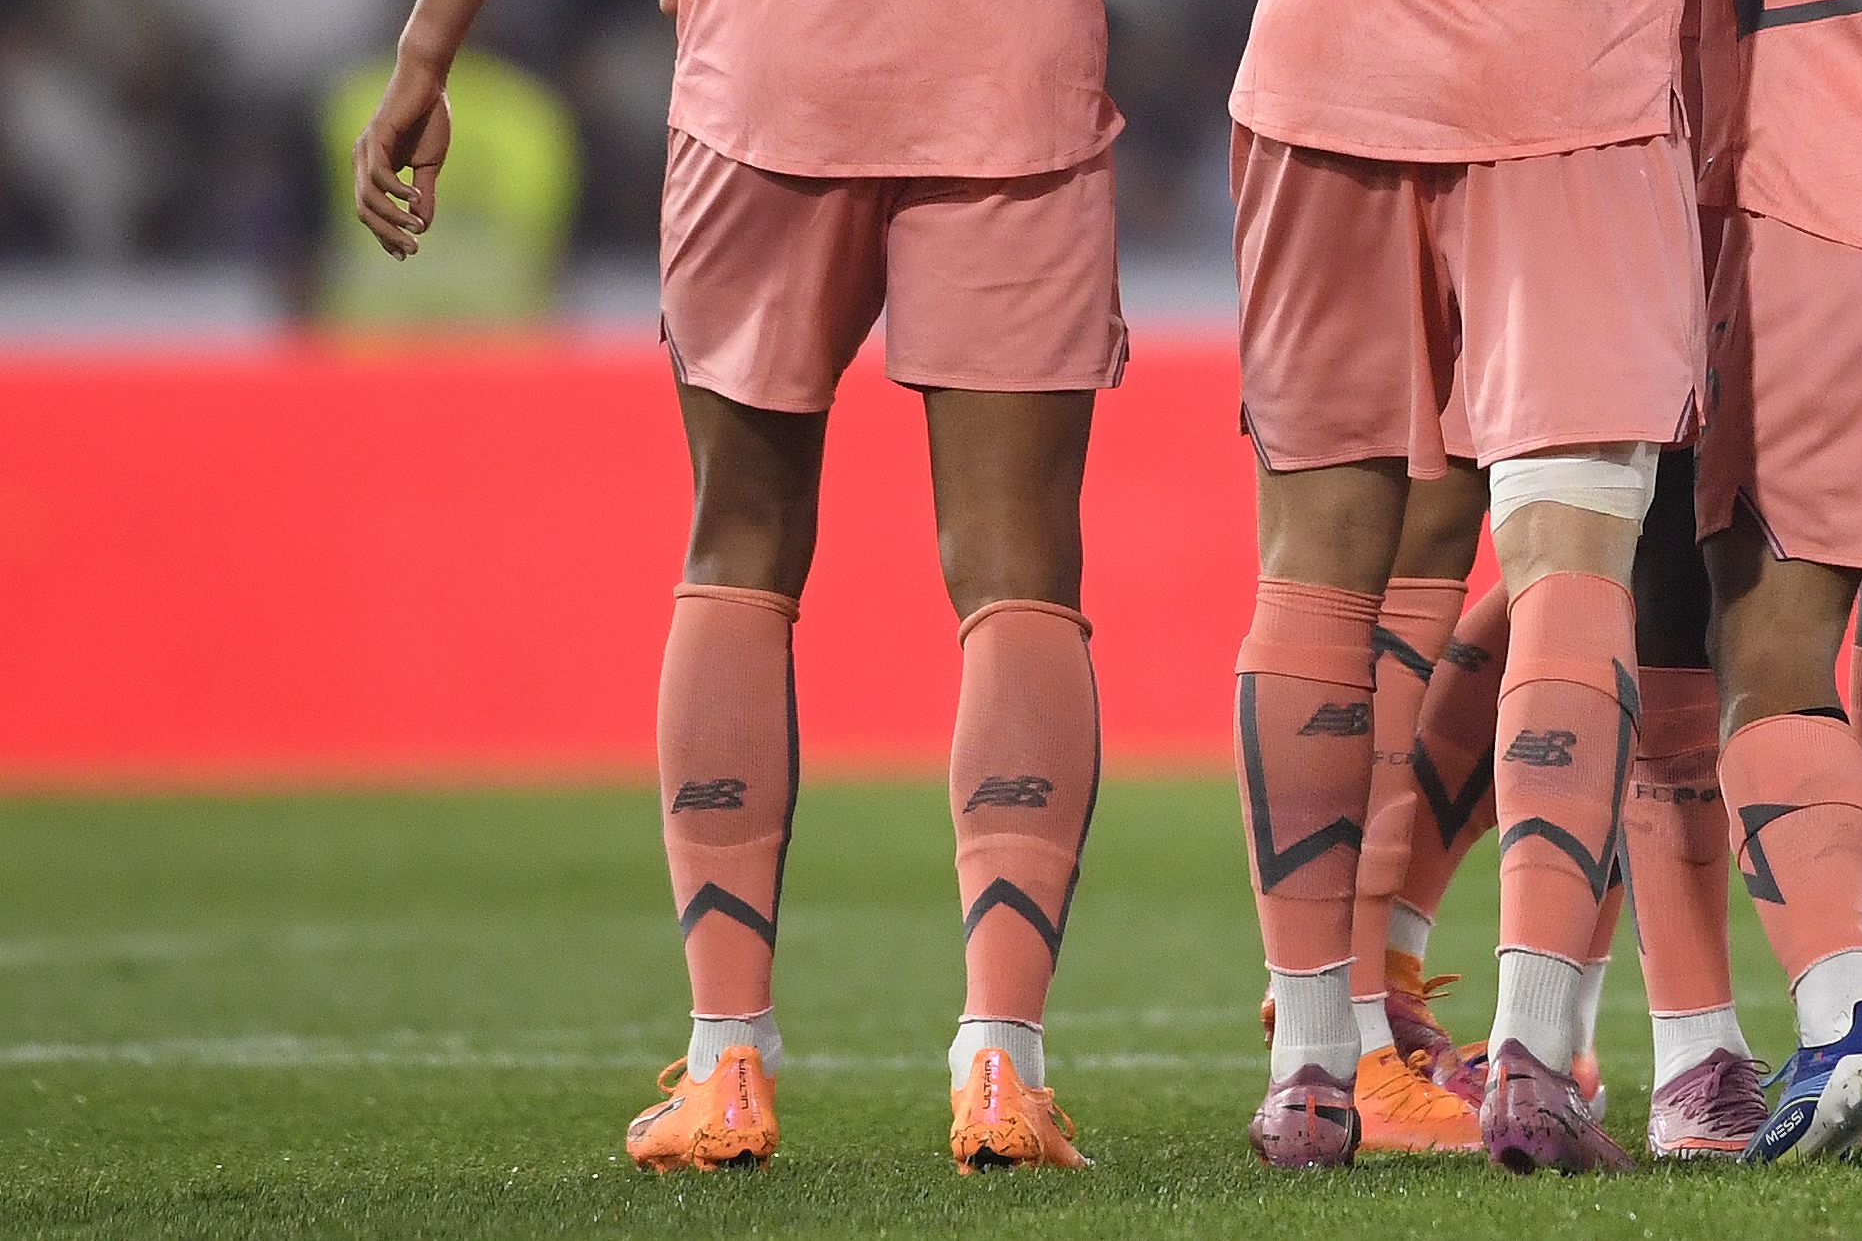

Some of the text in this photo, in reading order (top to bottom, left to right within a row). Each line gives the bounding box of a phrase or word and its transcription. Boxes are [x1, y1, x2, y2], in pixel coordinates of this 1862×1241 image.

[738, 1058, 749, 1110] ULTRA
[983, 1059, 992, 1110] ULTRA
[1765, 1107, 1805, 1146] MESSI
